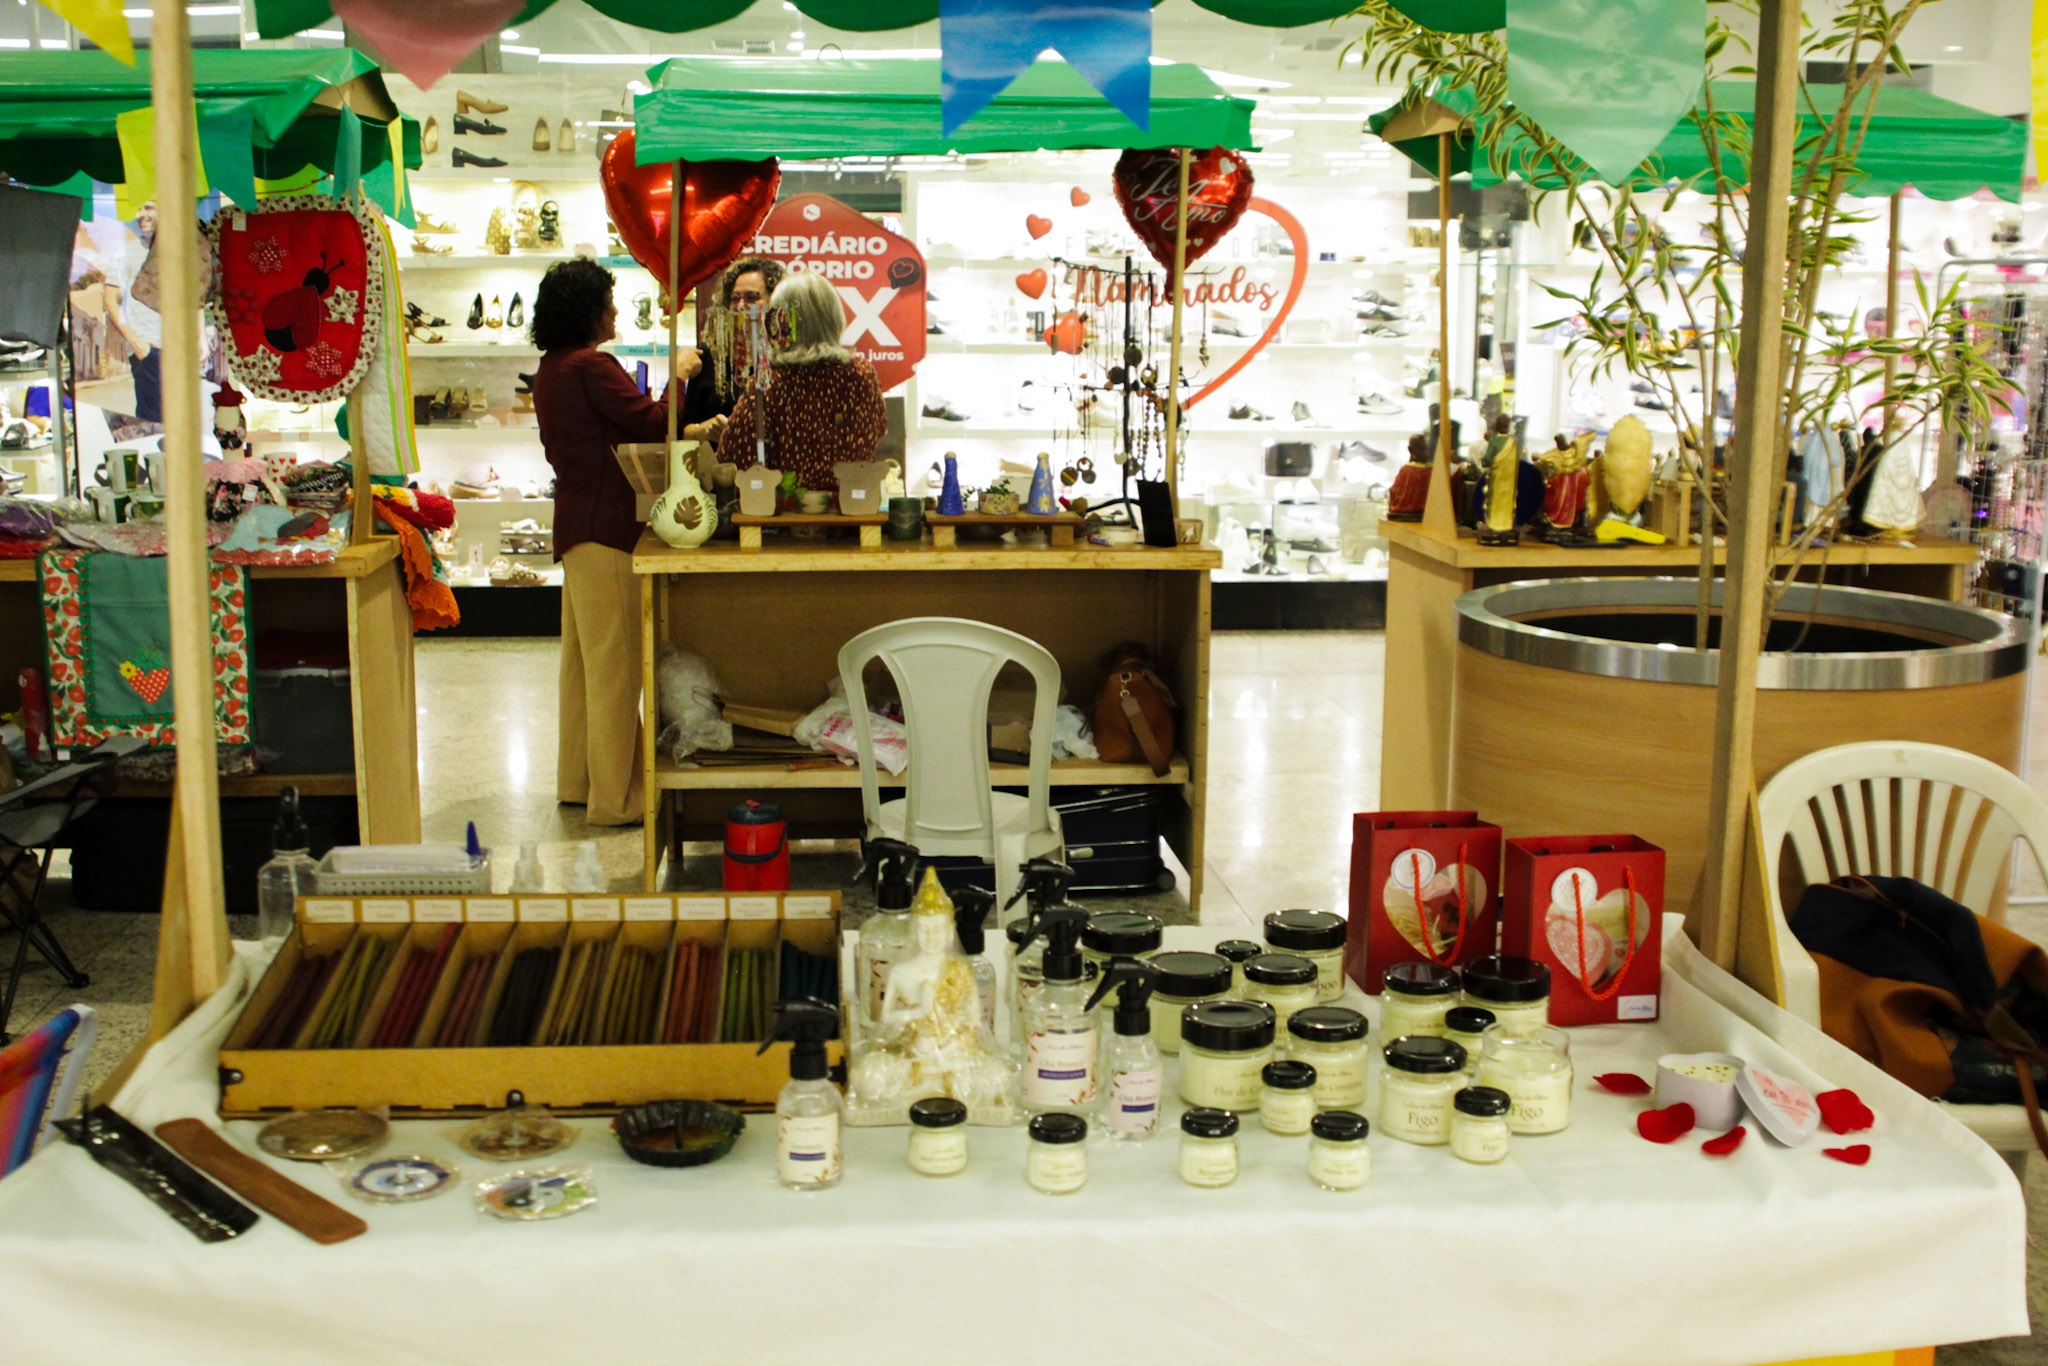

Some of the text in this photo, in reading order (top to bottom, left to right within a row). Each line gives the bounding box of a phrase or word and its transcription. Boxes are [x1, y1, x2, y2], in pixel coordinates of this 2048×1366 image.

[868, 349, 905, 363] juros
[1407, 1111, 1439, 1129] Figo
[1511, 1103, 1544, 1121] Figo
